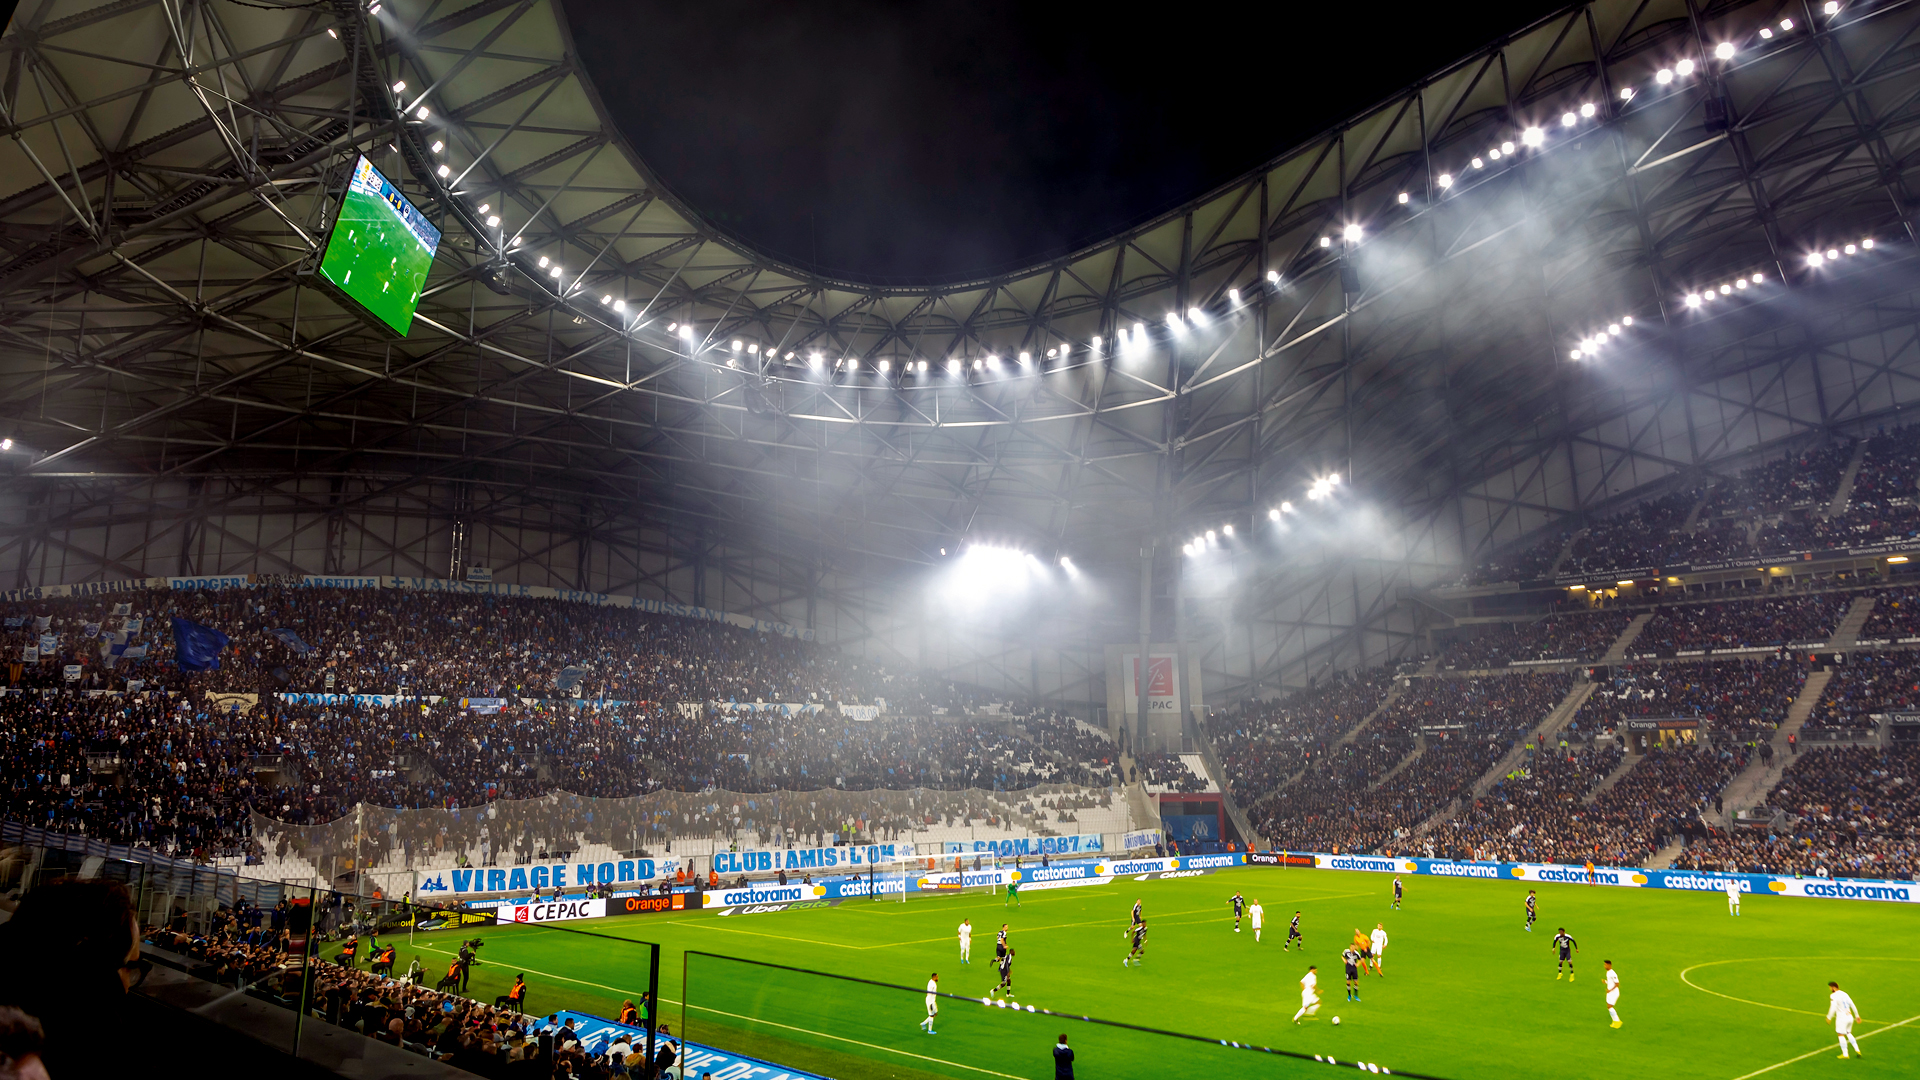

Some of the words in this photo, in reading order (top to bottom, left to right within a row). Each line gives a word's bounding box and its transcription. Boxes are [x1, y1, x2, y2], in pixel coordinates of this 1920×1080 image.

[1849, 546, 1887, 556] Bienvenue
[1691, 563, 1724, 571] Bienvenue
[70, 579, 148, 598] MARSEILLE
[301, 577, 376, 590] ARSEILLE
[411, 576, 531, 598] MARSEILLE
[1630, 721, 1657, 730] Orange
[1036, 835, 1079, 855] 1987
[714, 852, 773, 874] CLUB
[785, 847, 838, 870] AMIS
[850, 843, 896, 865] L'OM
[1188, 854, 1234, 869] castorama
[1251, 853, 1278, 865] Orange
[1331, 857, 1396, 872] castorama
[451, 864, 567, 893] VIRAGE
[576, 858, 656, 887] NORD
[1032, 865, 1086, 882] castorama
[1113, 860, 1164, 876] castorama
[1159, 869, 1204, 879] CANAL+
[1430, 862, 1498, 878] castorama
[724, 886, 802, 906] castorama
[1803, 881, 1910, 902] castorama
[533, 901, 590, 921] CEPAC
[625, 897, 670, 912] Orange
[741, 904, 788, 915] Uber
[787, 900, 832, 911] Eats
